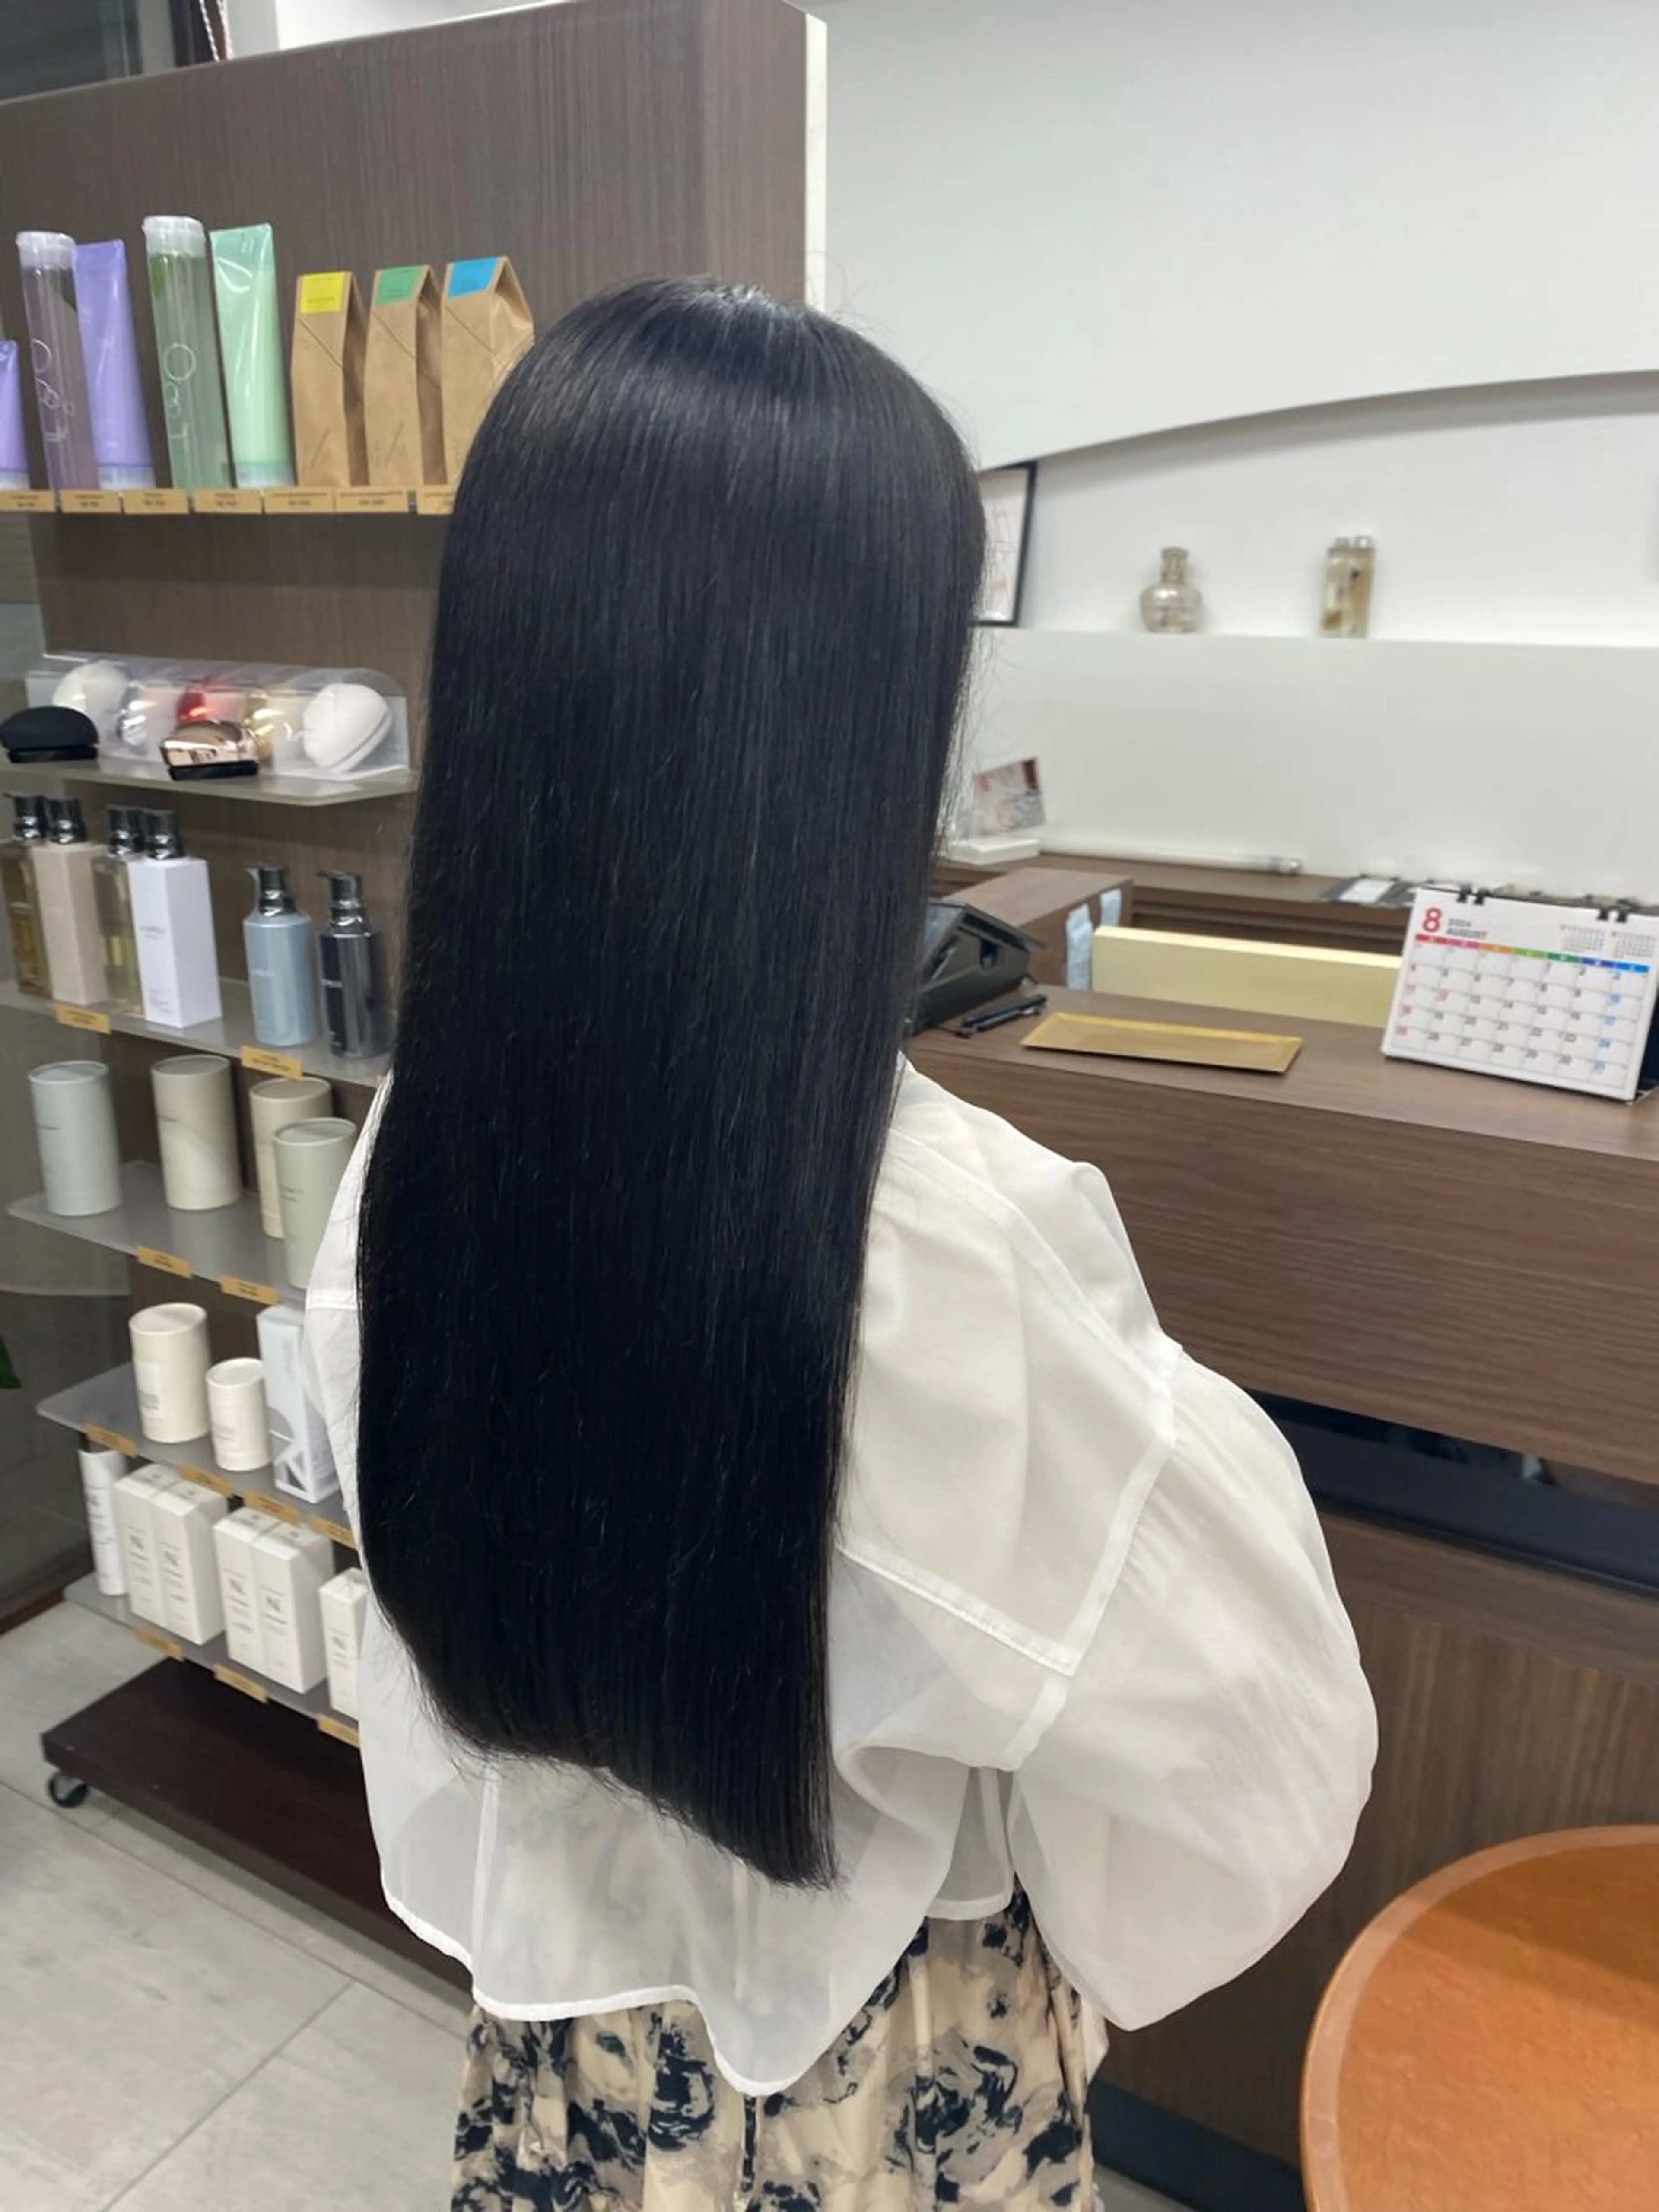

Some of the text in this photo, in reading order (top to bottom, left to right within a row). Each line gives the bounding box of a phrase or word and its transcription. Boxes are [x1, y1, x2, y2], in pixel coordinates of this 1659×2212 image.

[1422, 907, 1443, 933] 8
[1411, 963, 1417, 972] 4
[1578, 966, 1586, 976] 2
